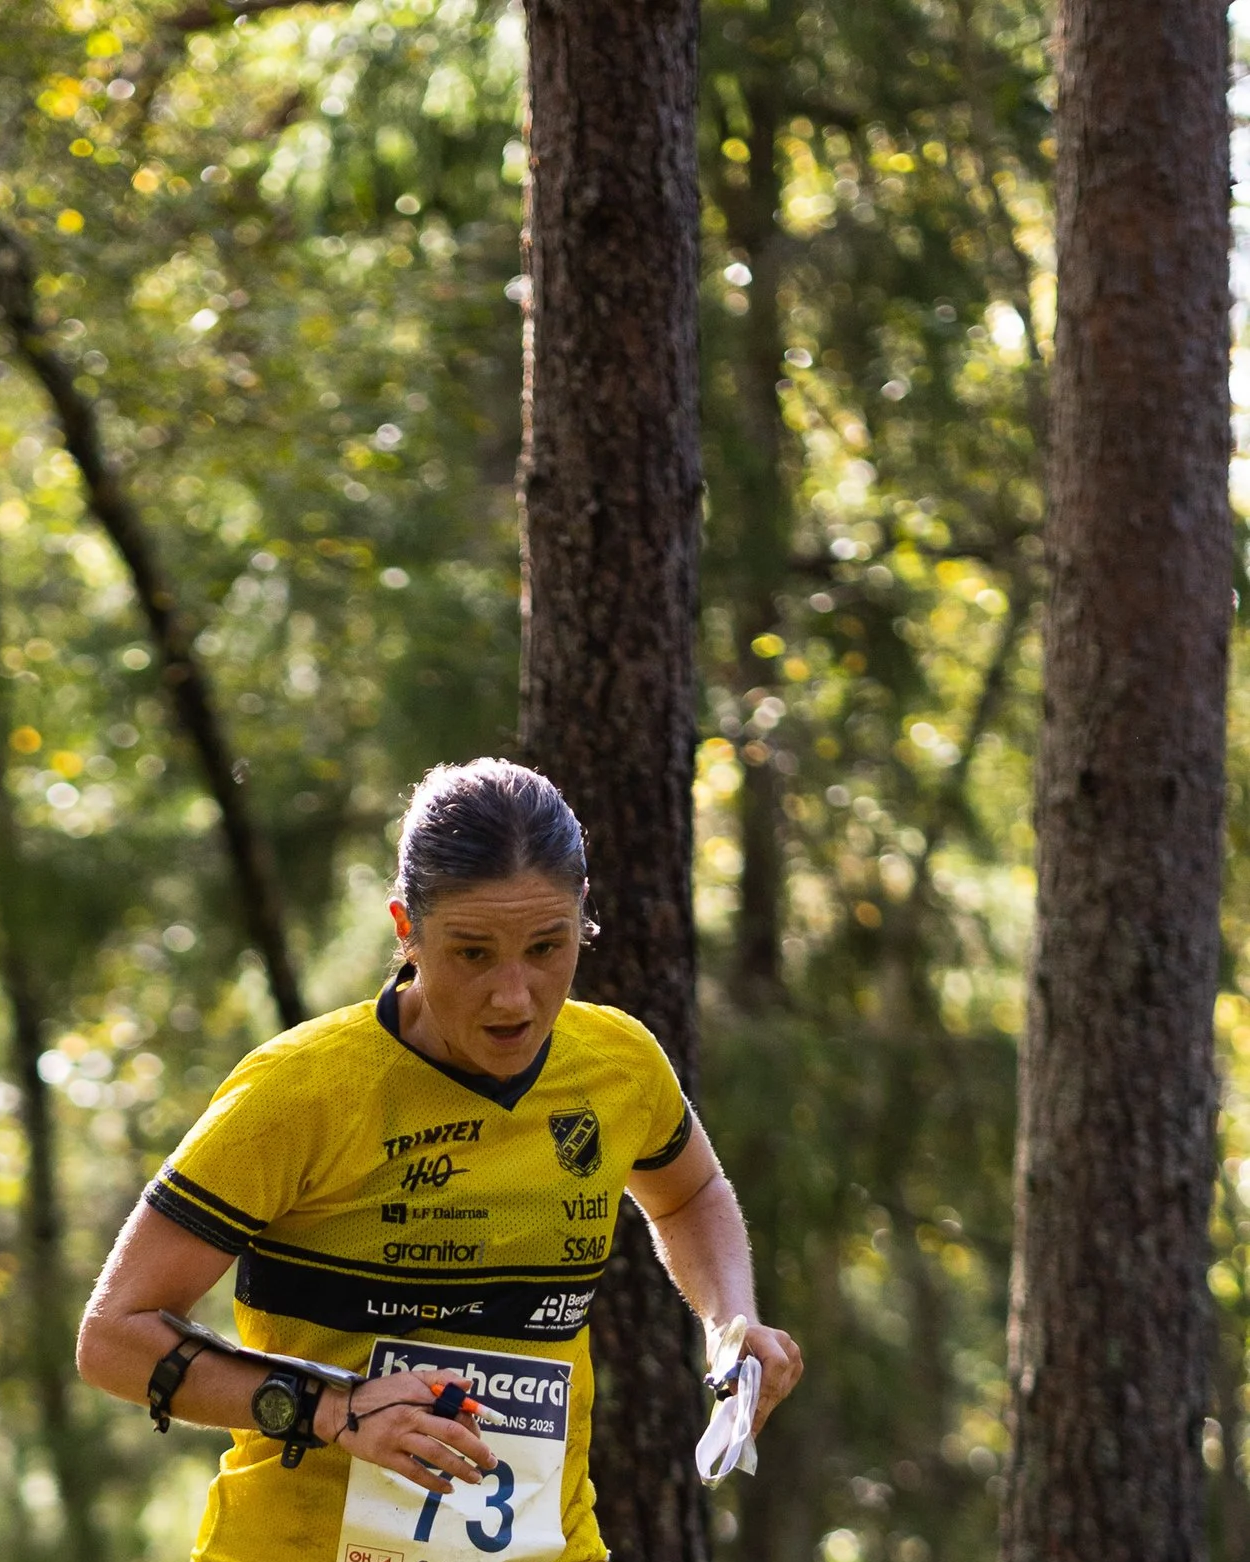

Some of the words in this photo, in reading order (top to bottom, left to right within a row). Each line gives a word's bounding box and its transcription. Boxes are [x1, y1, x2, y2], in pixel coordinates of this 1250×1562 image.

[562, 1190, 608, 1221] viati
[383, 1240, 478, 1264] granitor
[561, 1235, 607, 1262] SSAB
[529, 1418, 555, 1433] 2025
